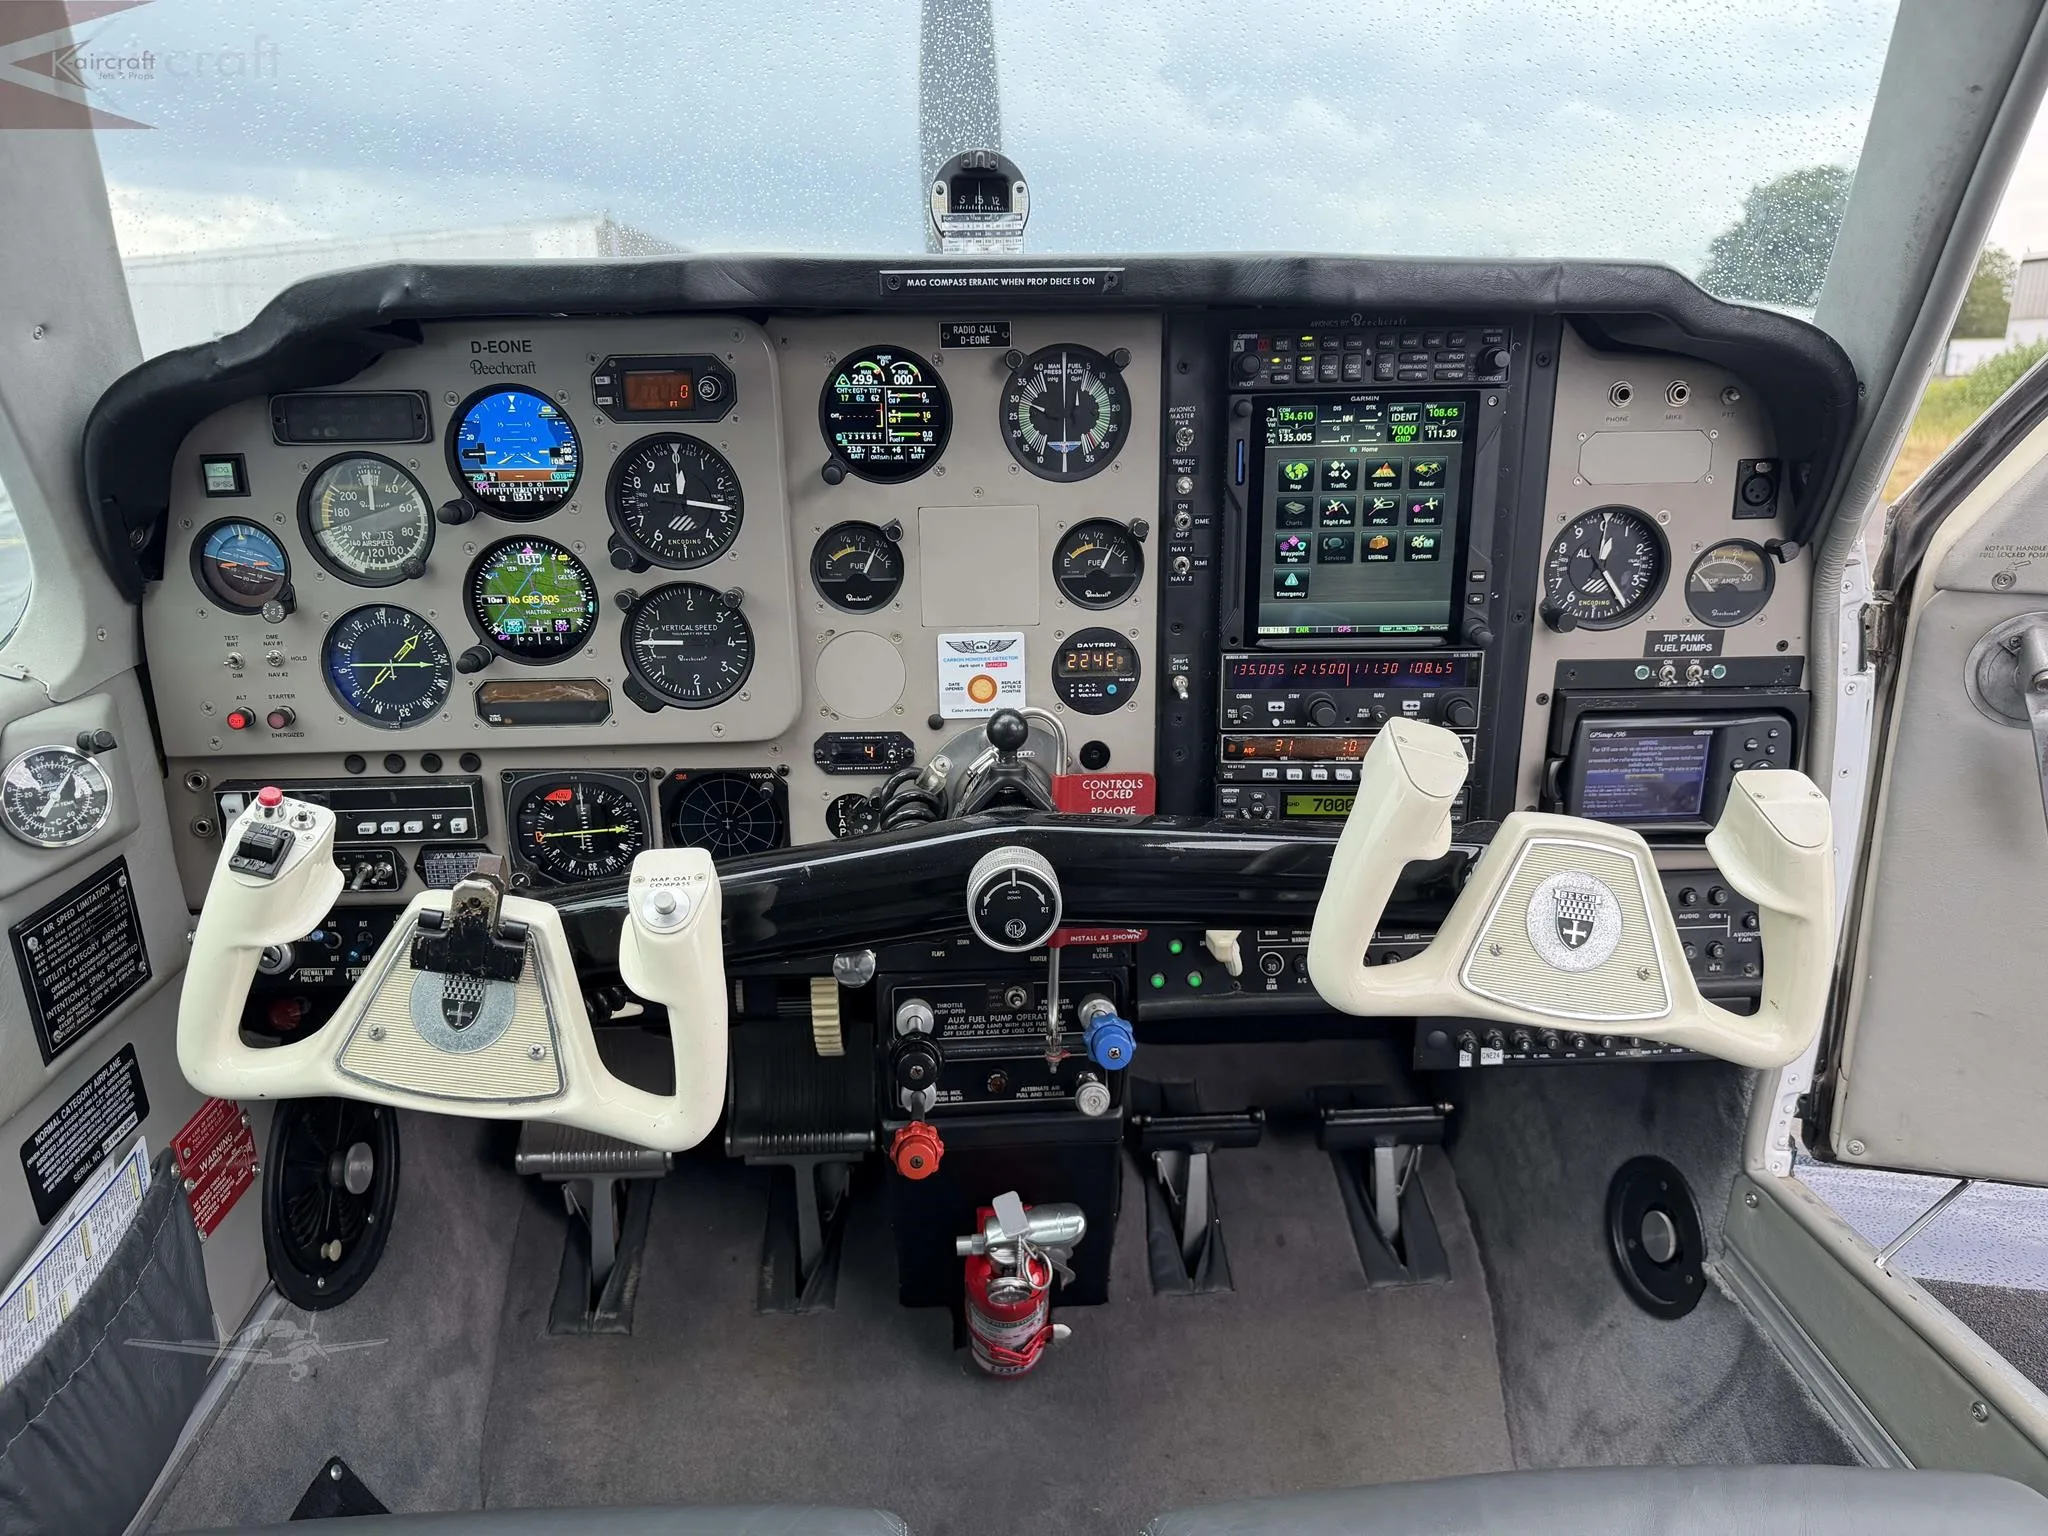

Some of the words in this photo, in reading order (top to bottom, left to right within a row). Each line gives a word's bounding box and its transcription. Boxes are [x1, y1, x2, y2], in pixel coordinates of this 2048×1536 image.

[907, 279, 927, 287] MAG
[929, 279, 966, 287] COMPASS
[969, 278, 999, 286] ERRATIC
[1001, 278, 1024, 286] WHEN
[1027, 278, 1048, 286] PROP
[953, 326, 976, 334] RADIO
[979, 325, 997, 333] CALL
[961, 336, 990, 344] D-EONE
[470, 340, 532, 354] D-EONE
[470, 359, 536, 375] Beechcraft
[852, 375, 872, 384] 29.9
[894, 375, 913, 384] 000
[1280, 412, 1313, 421] 134.610
[1429, 408, 1458, 417] 108.65
[1392, 413, 1417, 422] IDENT
[1392, 426, 1416, 435] 7000
[1428, 429, 1457, 438] 111.30
[1279, 433, 1312, 441] 135.005
[385, 485, 398, 493] 40
[653, 483, 670, 493] ALT
[340, 492, 357, 500] 200
[334, 508, 349, 516] 180
[399, 504, 412, 512] 60
[401, 527, 414, 536] 80
[369, 549, 384, 557] 120
[388, 546, 403, 555] 100
[522, 595, 540, 603] GPS
[542, 595, 560, 603] POS
[1663, 634, 1678, 642] TIP
[1655, 644, 1678, 652] FUEL
[1680, 643, 1712, 651] PUMPS
[1233, 664, 1285, 675] 135.005
[1082, 779, 1143, 790] CONTROLS
[1091, 789, 1133, 799] LOCKED
[1091, 806, 1136, 815] REMOVE
[1561, 891, 1595, 902] BEECH
[43, 922, 55, 936] AIR
[56, 908, 76, 926] SPEED
[76, 883, 110, 912] LIMITATION
[981, 908, 988, 916] LT
[1041, 906, 1049, 914] RT
[43, 964, 67, 987] UTILITY
[68, 940, 99, 968] CATEGORY
[102, 921, 128, 944] AIRPLANE
[46, 985, 87, 1020] INTENTIONAL
[89, 969, 106, 987] SPINS
[107, 944, 138, 972] PROHIBITED
[1016, 1013, 1062, 1021] OPERATN
[35, 1116, 62, 1146] NORMAL
[61, 1083, 93, 1119] CATEGORY
[93, 1056, 122, 1088] AIRPLANE
[200, 1132, 233, 1172] WARNING
[73, 1160, 93, 1183] SERIAL
[92, 1150, 102, 1165] NO.
